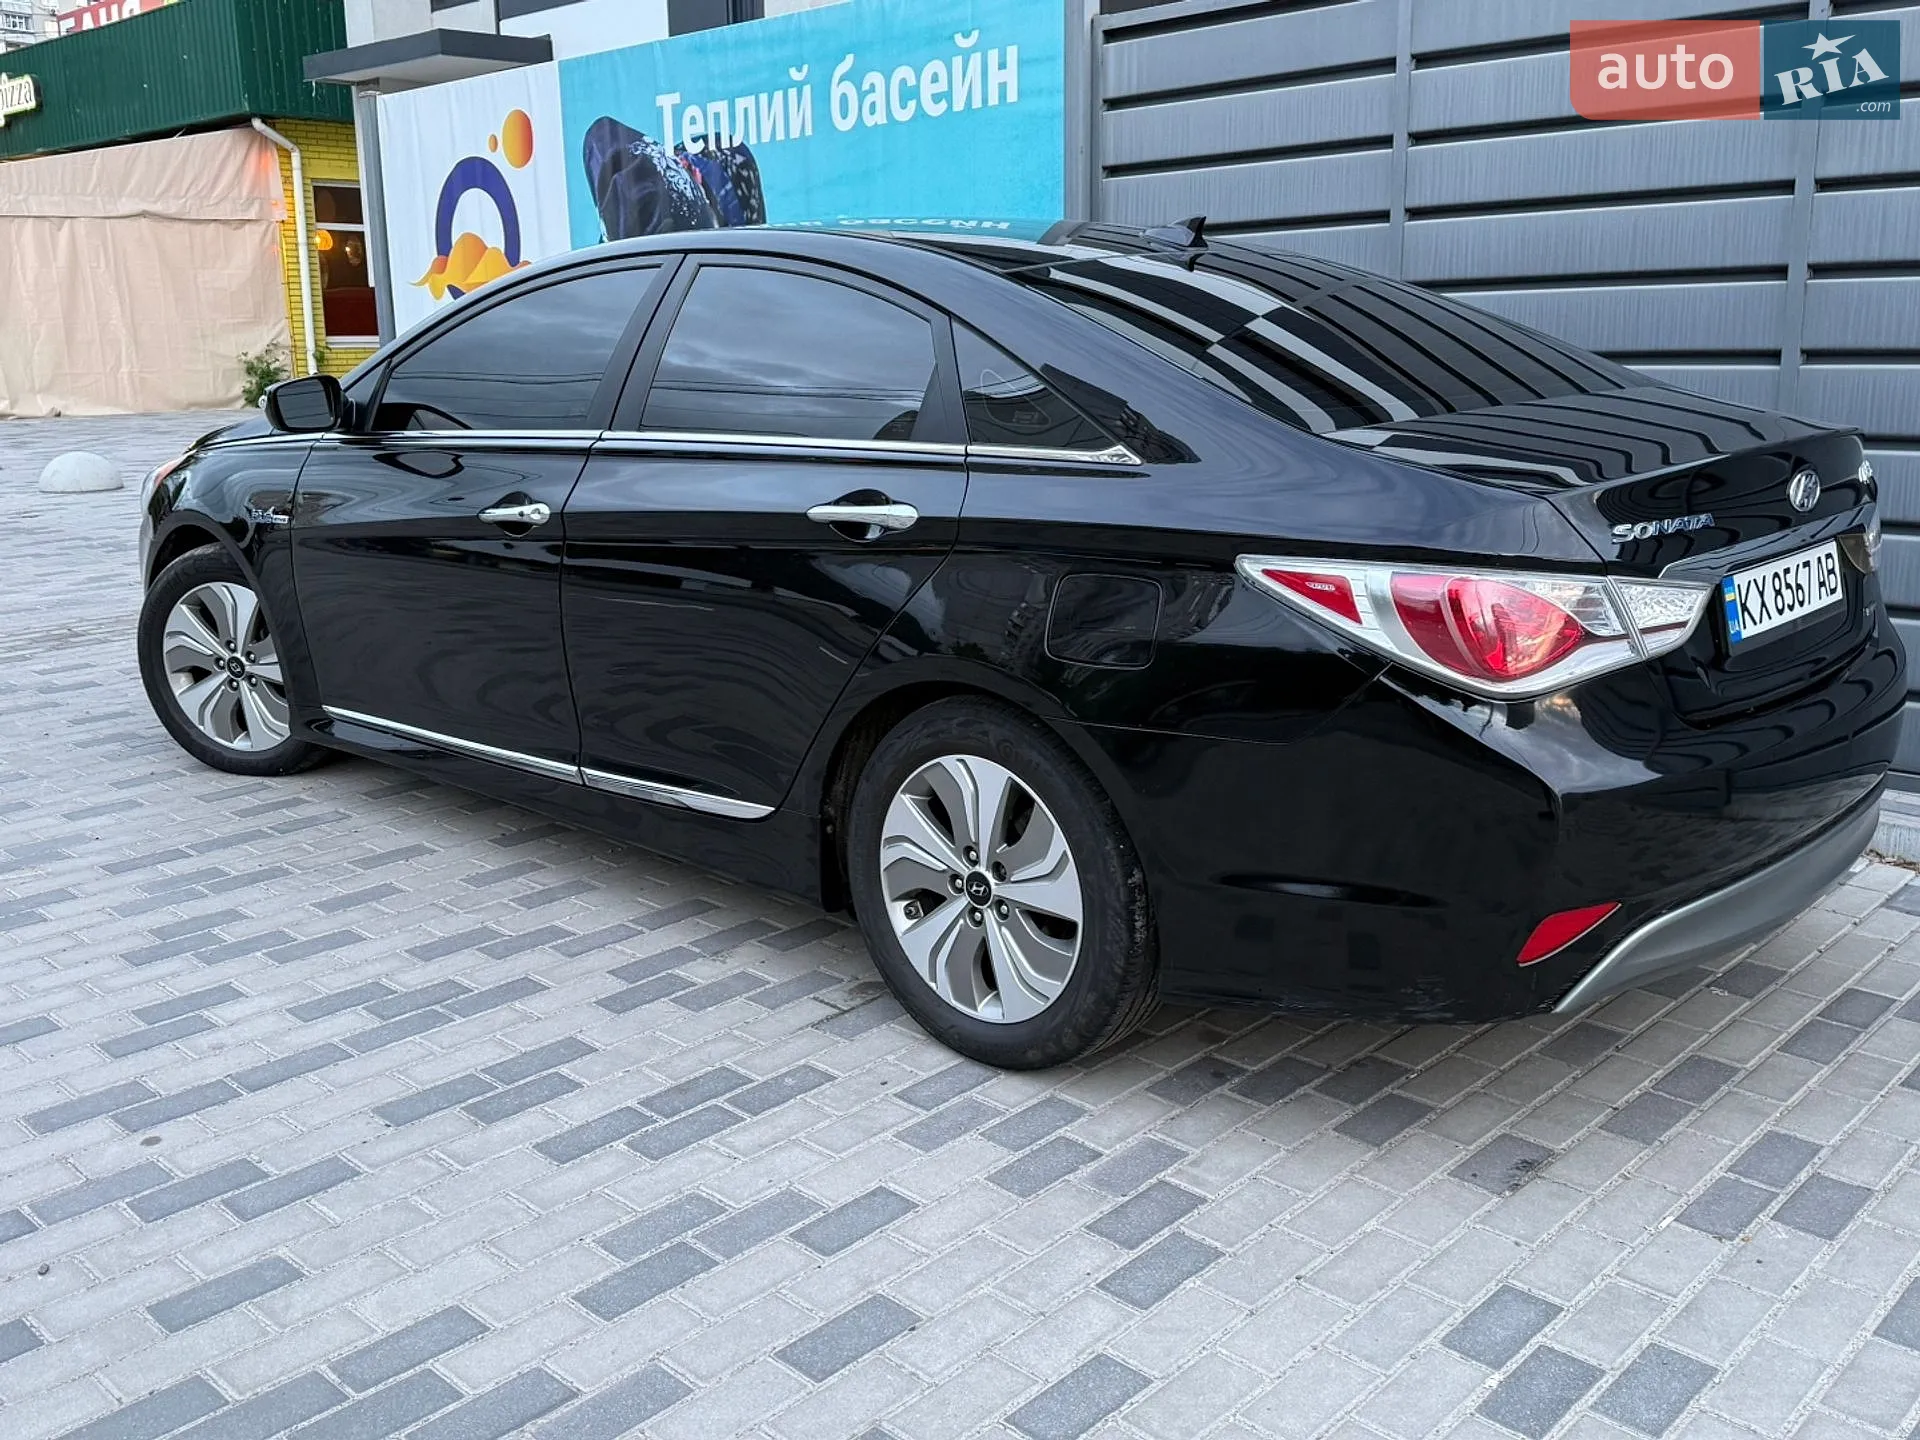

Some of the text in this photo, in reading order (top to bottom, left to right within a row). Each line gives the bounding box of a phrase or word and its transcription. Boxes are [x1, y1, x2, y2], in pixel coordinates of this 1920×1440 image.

[655, 29, 1020, 157] Теплий басейн
[1611, 512, 1716, 544] SONATA
[1772, 560, 1811, 616] 8567
